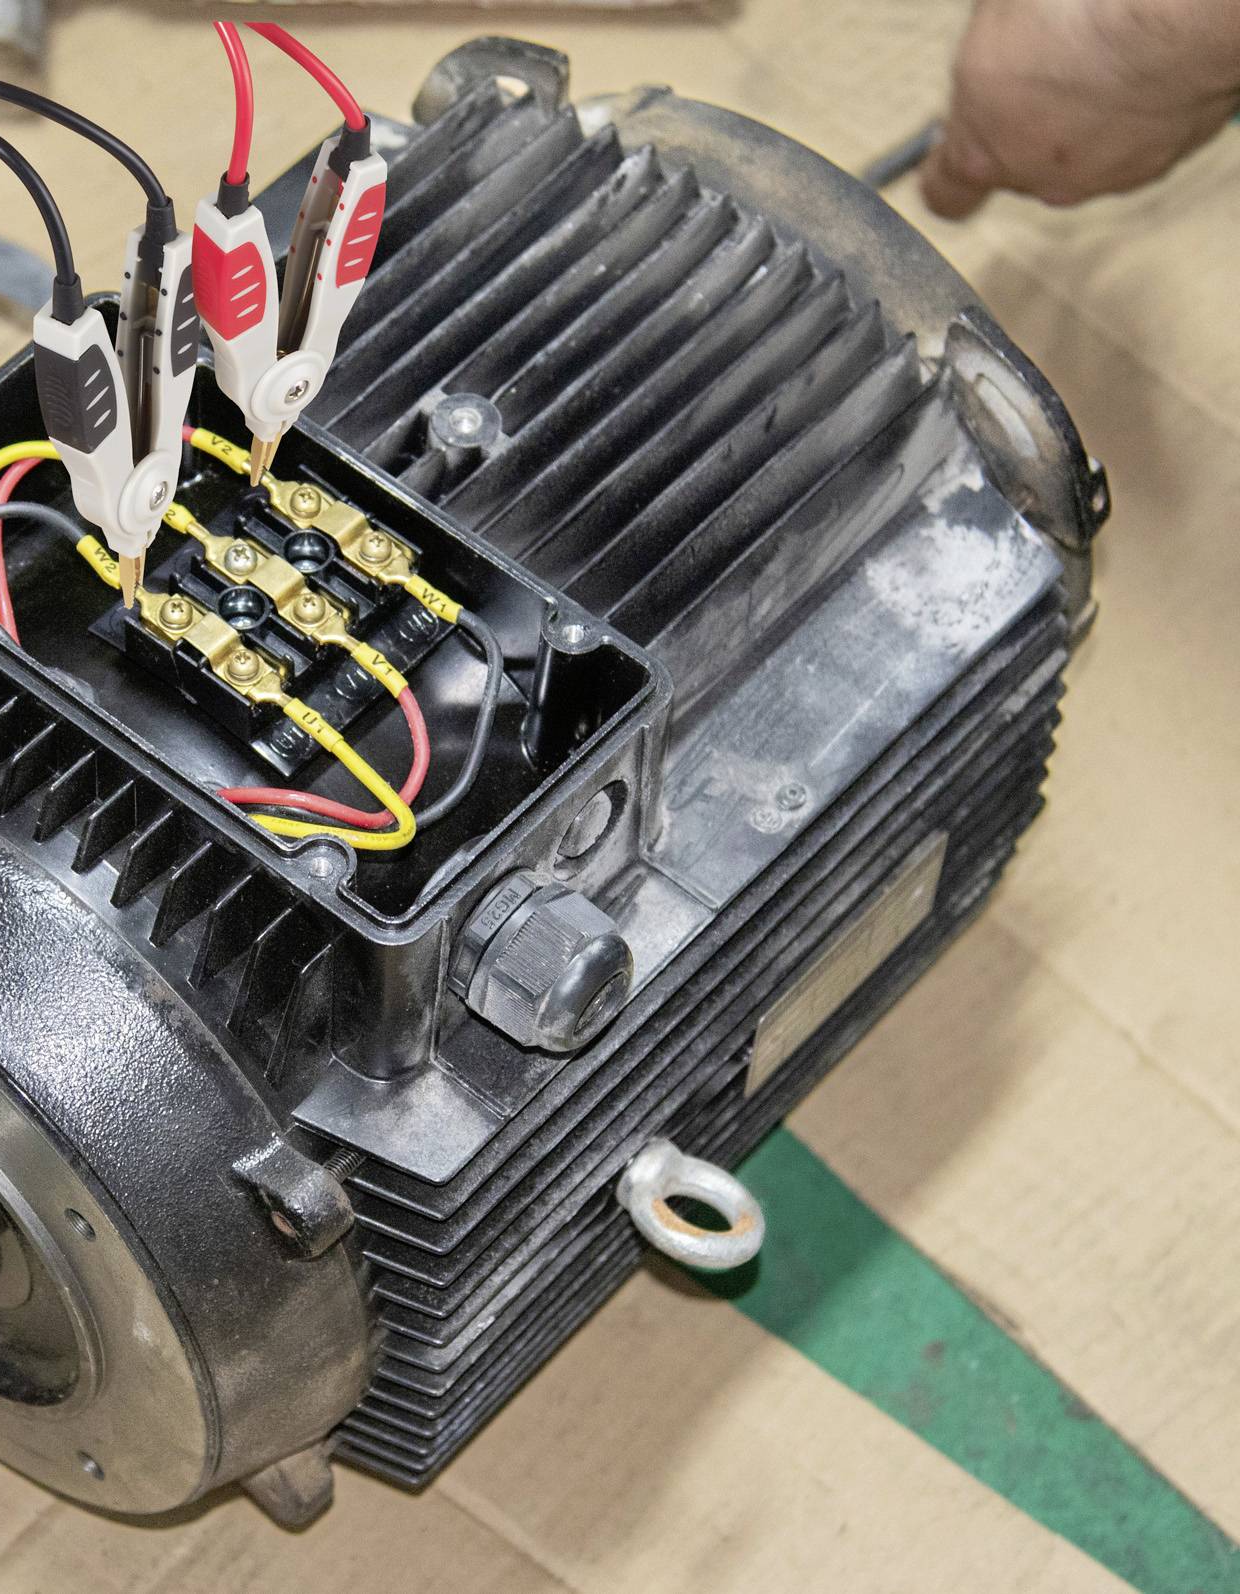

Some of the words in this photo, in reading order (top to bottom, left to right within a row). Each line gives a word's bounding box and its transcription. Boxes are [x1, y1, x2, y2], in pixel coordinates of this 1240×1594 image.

[211, 436, 233, 456] V2
[94, 547, 117, 573] W2
[422, 588, 447, 613] W1
[371, 654, 394, 676] V1
[302, 712, 325, 734] U1
